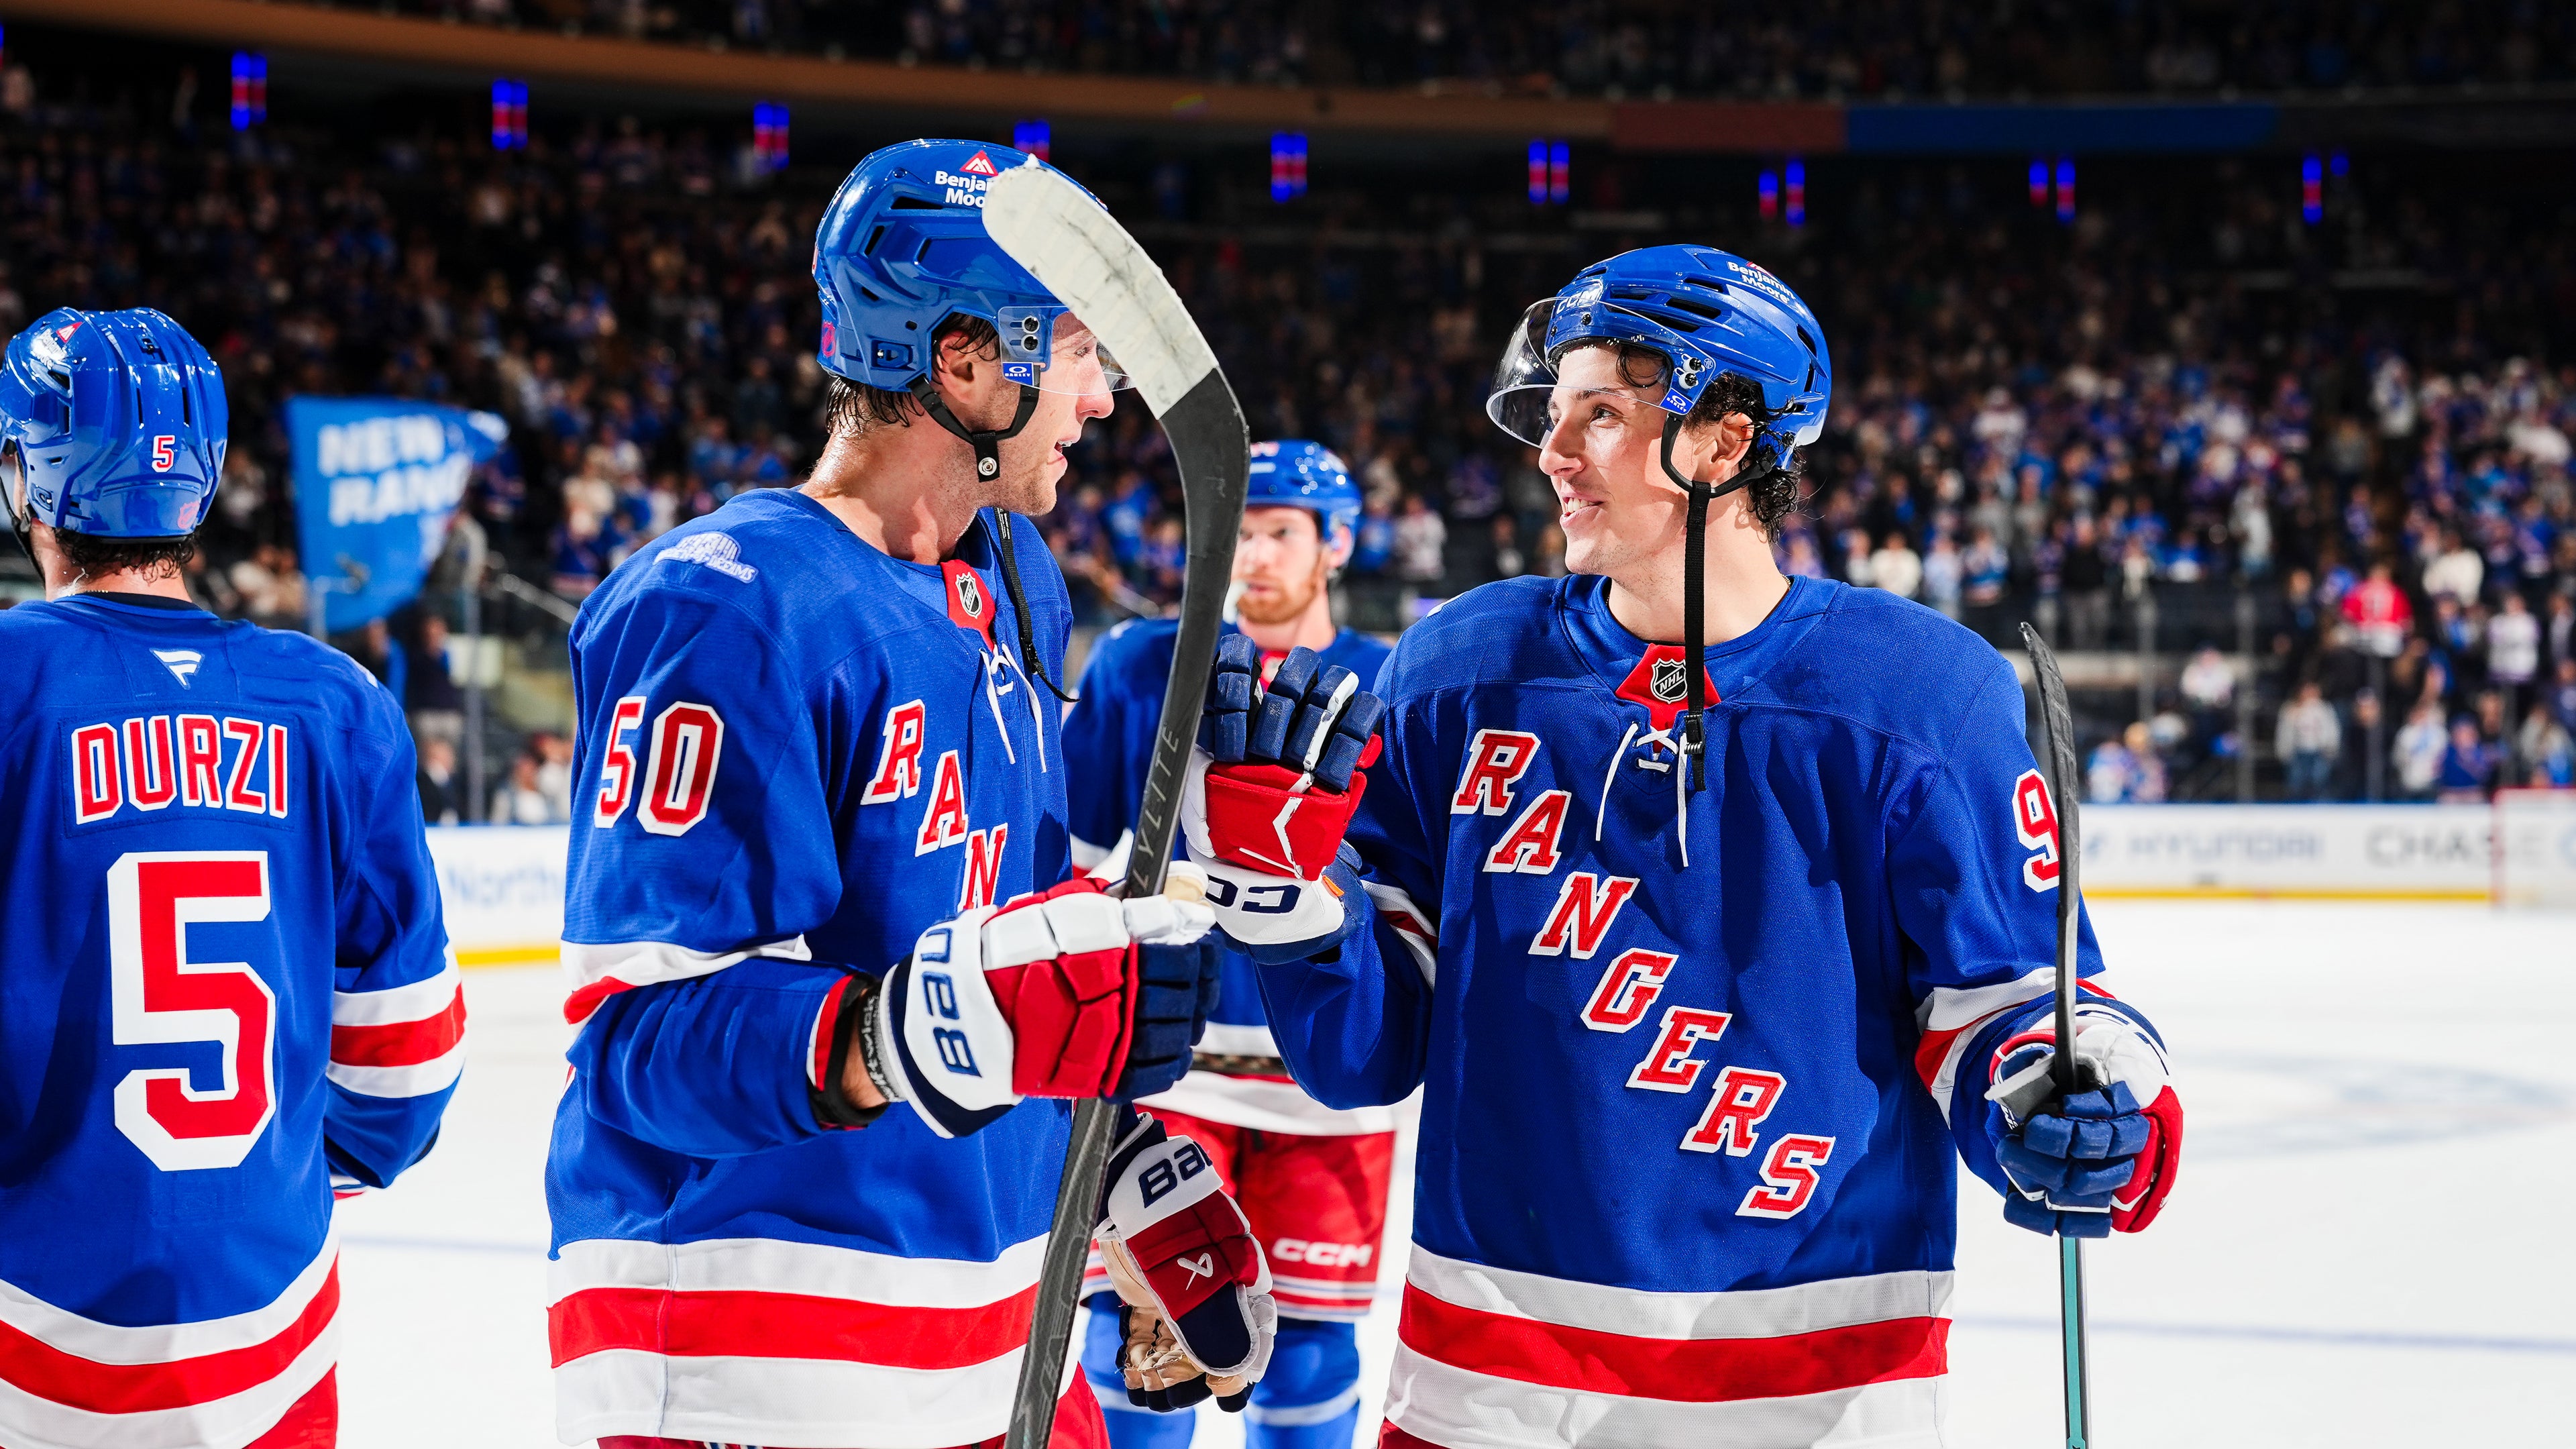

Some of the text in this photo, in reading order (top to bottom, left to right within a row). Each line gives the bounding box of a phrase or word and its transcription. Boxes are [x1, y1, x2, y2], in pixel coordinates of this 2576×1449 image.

[934, 170, 992, 193] Benja
[945, 187, 985, 208] Moo
[1727, 261, 1796, 300] Benjamin
[1741, 274, 1789, 304] Moore
[1666, 397, 1687, 412] OAKLEY
[152, 435, 175, 472] 5
[317, 414, 445, 478] NEW
[1659, 671, 1683, 694] NHL
[72, 714, 288, 824] DURZI
[594, 696, 724, 837] 50
[861, 698, 1033, 913] RAN
[1128, 722, 1179, 896] LYLITE
[2012, 767, 2059, 893] 9
[1205, 873, 1303, 914] CC
[1450, 729, 1837, 1220] RANGERS
[107, 851, 276, 1171] 5
[920, 928, 982, 1077] Bau
[1272, 1237, 1373, 1268] CCM
